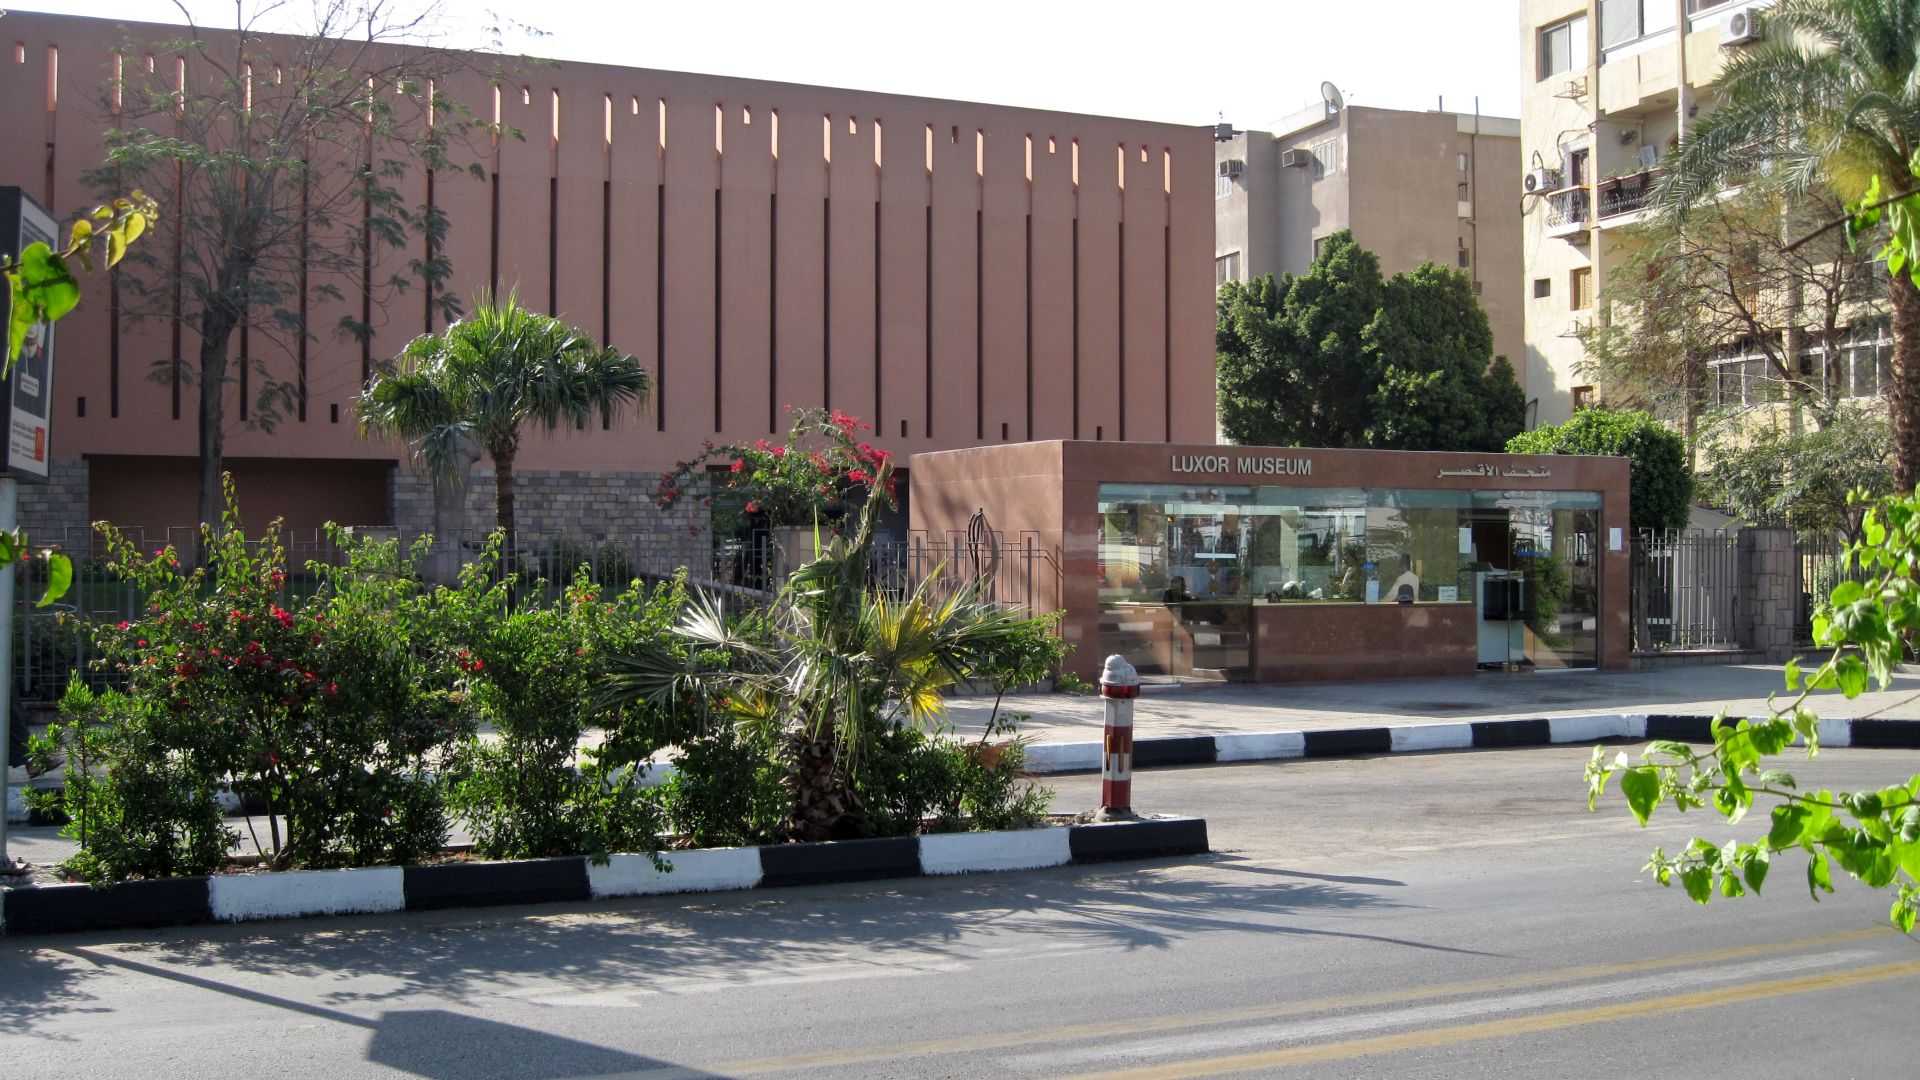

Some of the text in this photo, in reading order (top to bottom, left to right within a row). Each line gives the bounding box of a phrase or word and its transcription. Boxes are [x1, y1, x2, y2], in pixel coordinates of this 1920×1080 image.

[1172, 456, 1311, 475] LUXOR MUSEUM
[1503, 465, 1551, 477] متحف
